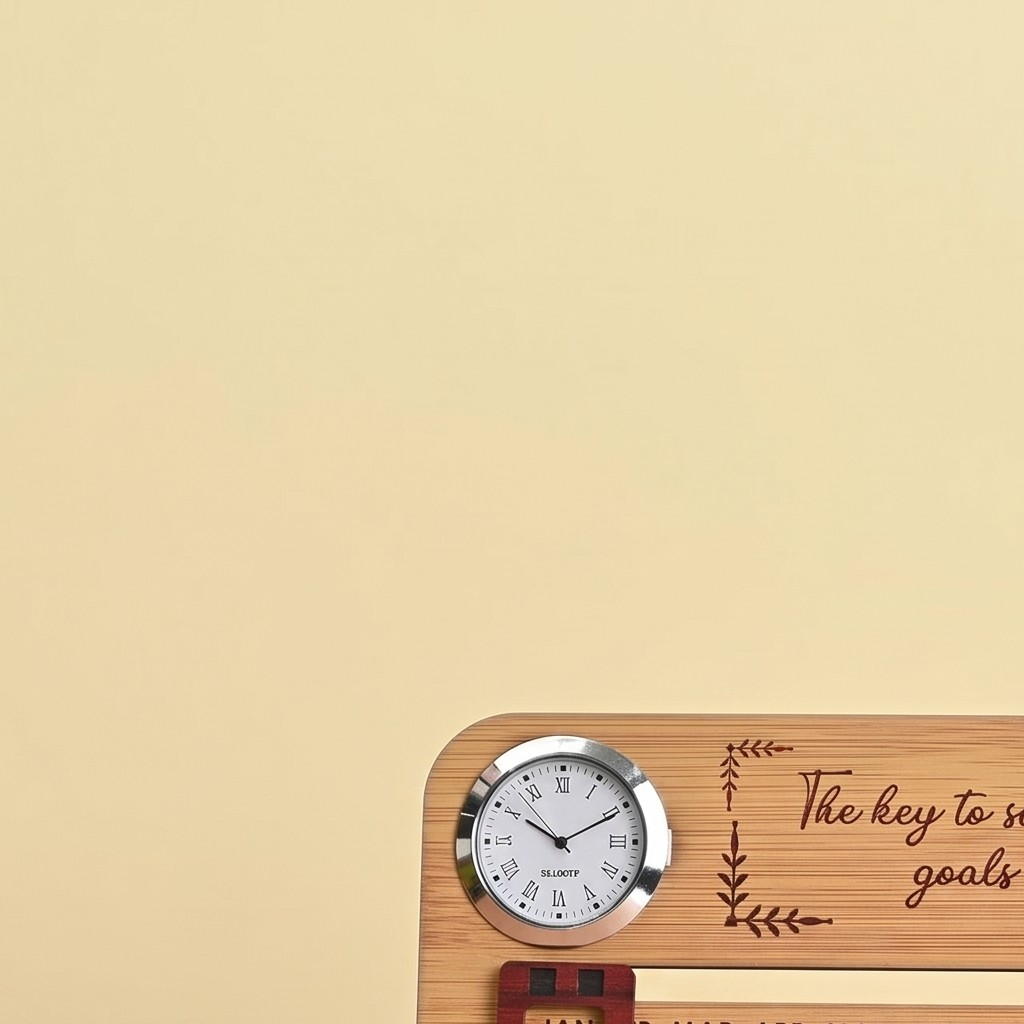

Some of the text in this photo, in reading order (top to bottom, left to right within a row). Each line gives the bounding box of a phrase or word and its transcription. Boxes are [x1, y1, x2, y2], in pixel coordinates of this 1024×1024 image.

[555, 777, 570, 793] XII
[505, 806, 521, 820] X
[799, 770, 863, 830] The
[871, 785, 945, 846] key
[954, 790, 994, 826] to
[609, 834, 626, 849] III
[905, 847, 1021, 909] goals
[584, 884, 596, 901] V
